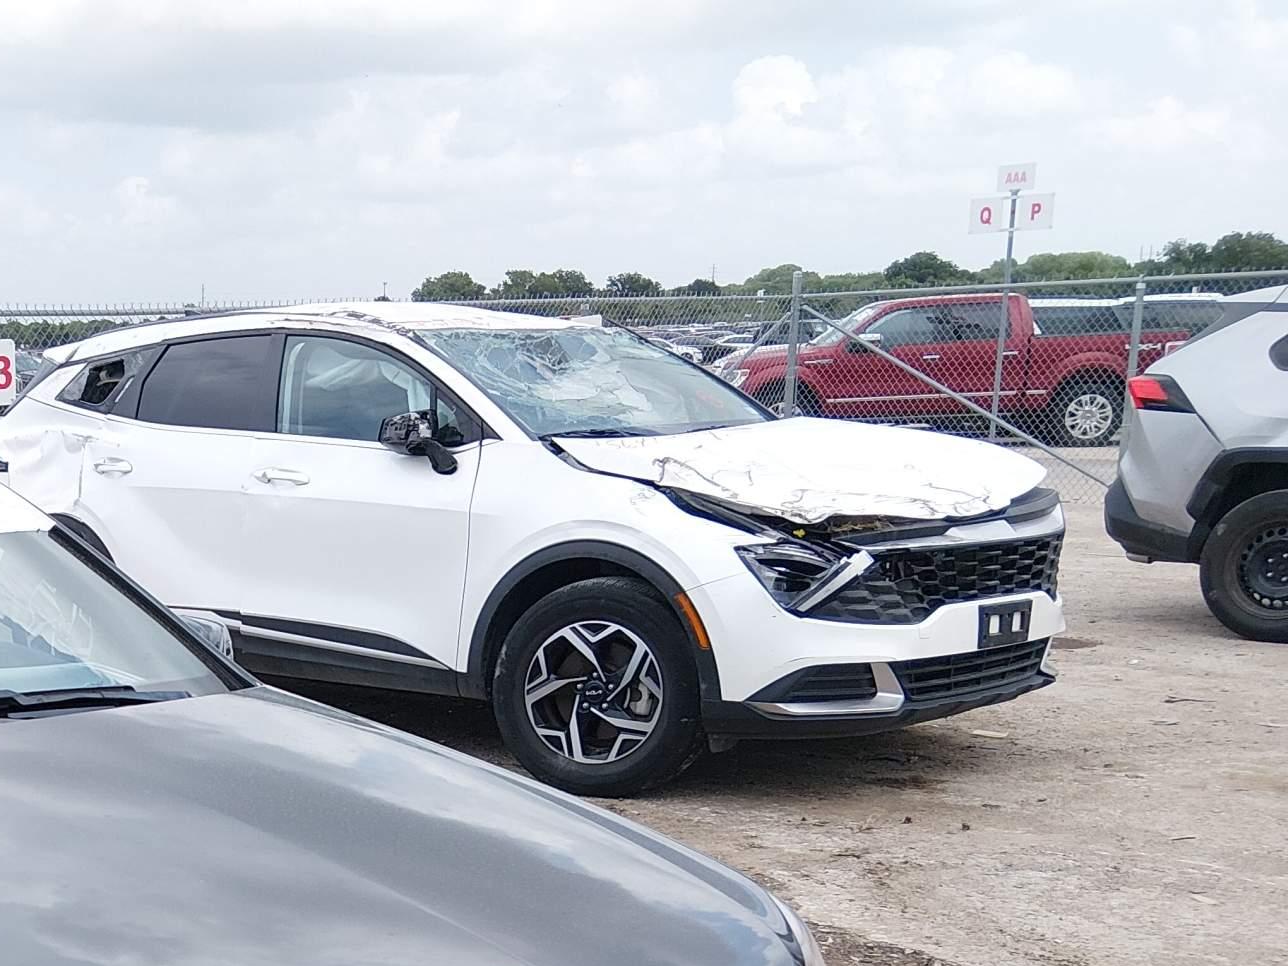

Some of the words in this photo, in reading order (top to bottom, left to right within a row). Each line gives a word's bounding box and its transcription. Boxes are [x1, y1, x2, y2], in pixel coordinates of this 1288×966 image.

[1005, 171, 1027, 184] AAA
[980, 206, 992, 225] Q
[1030, 203, 1042, 221] P
